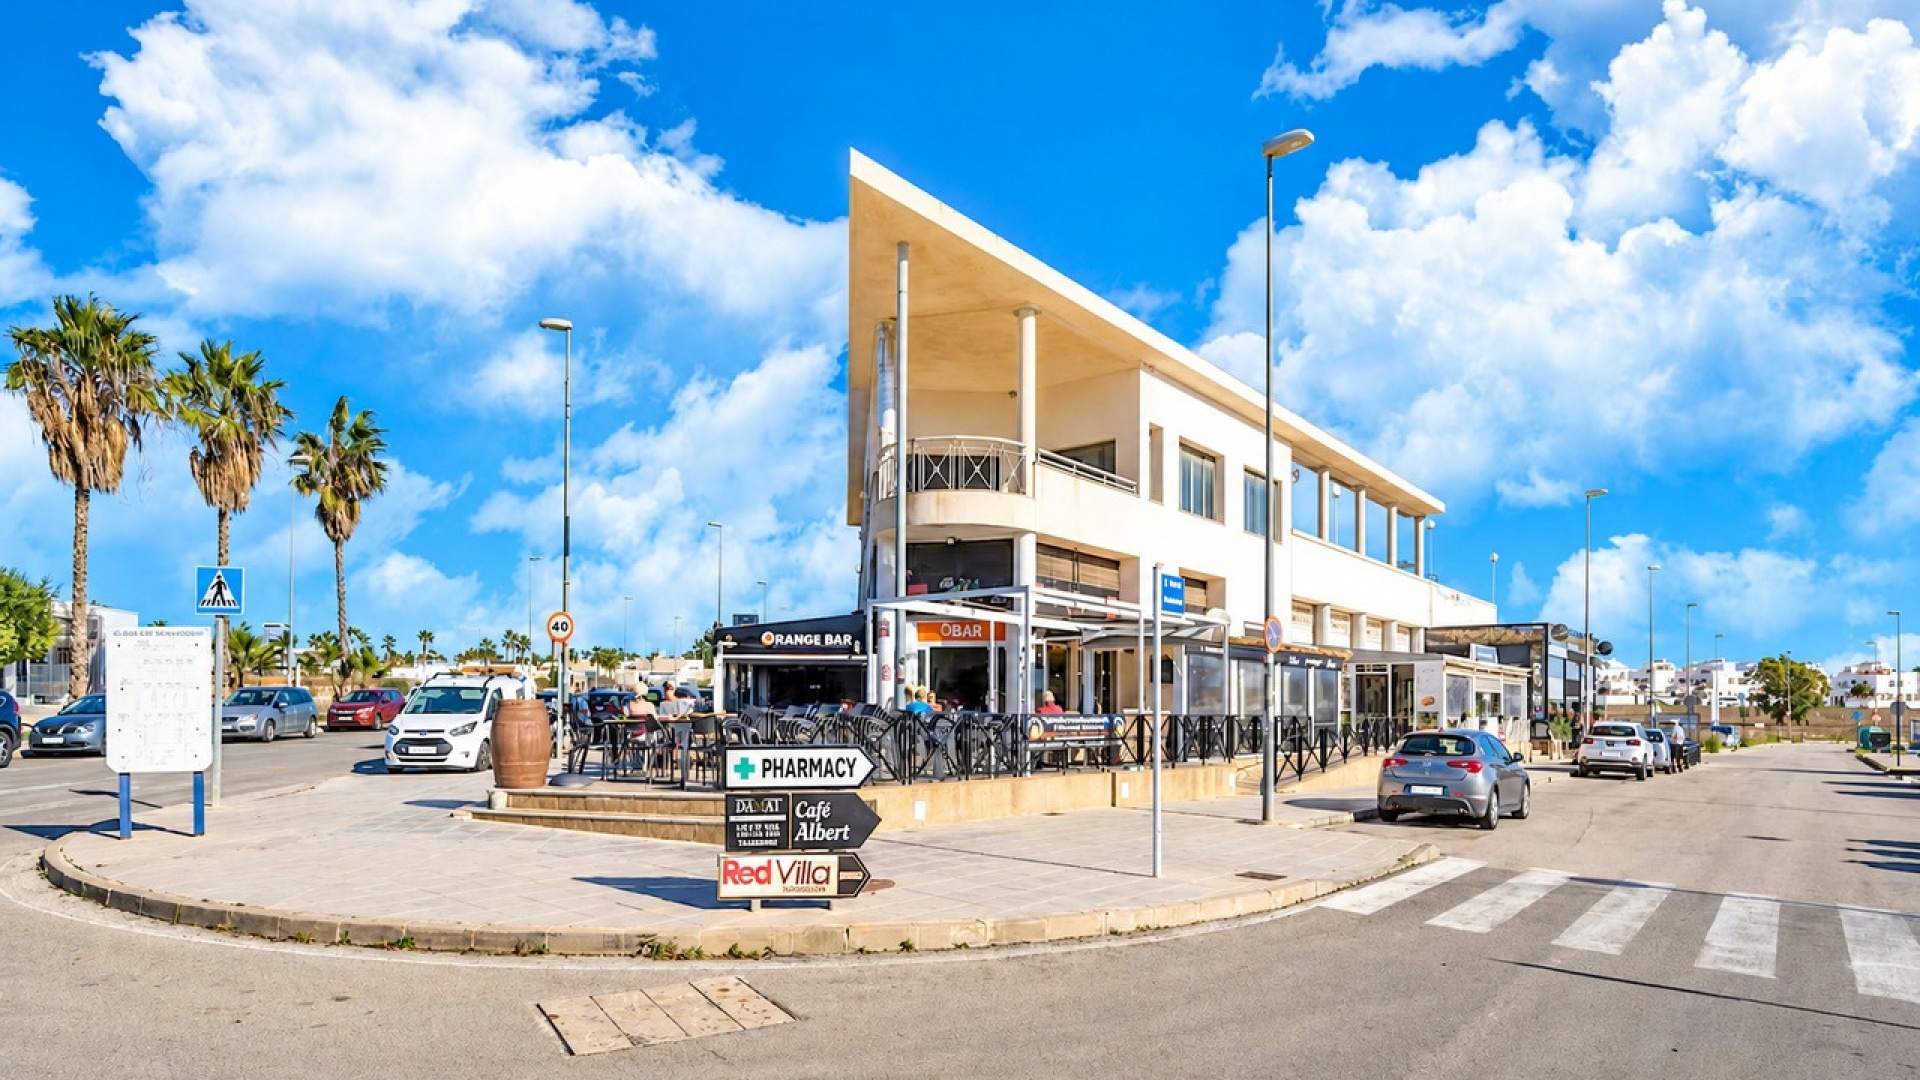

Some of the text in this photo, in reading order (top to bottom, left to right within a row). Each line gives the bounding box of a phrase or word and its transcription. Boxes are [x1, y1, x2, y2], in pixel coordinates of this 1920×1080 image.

[551, 620, 569, 632] 40
[761, 631, 853, 648] ORANGE BAR
[761, 757, 857, 778] PHARMACY
[795, 801, 831, 822] Café
[794, 822, 850, 841] Albert
[722, 859, 831, 886] Red Villa
